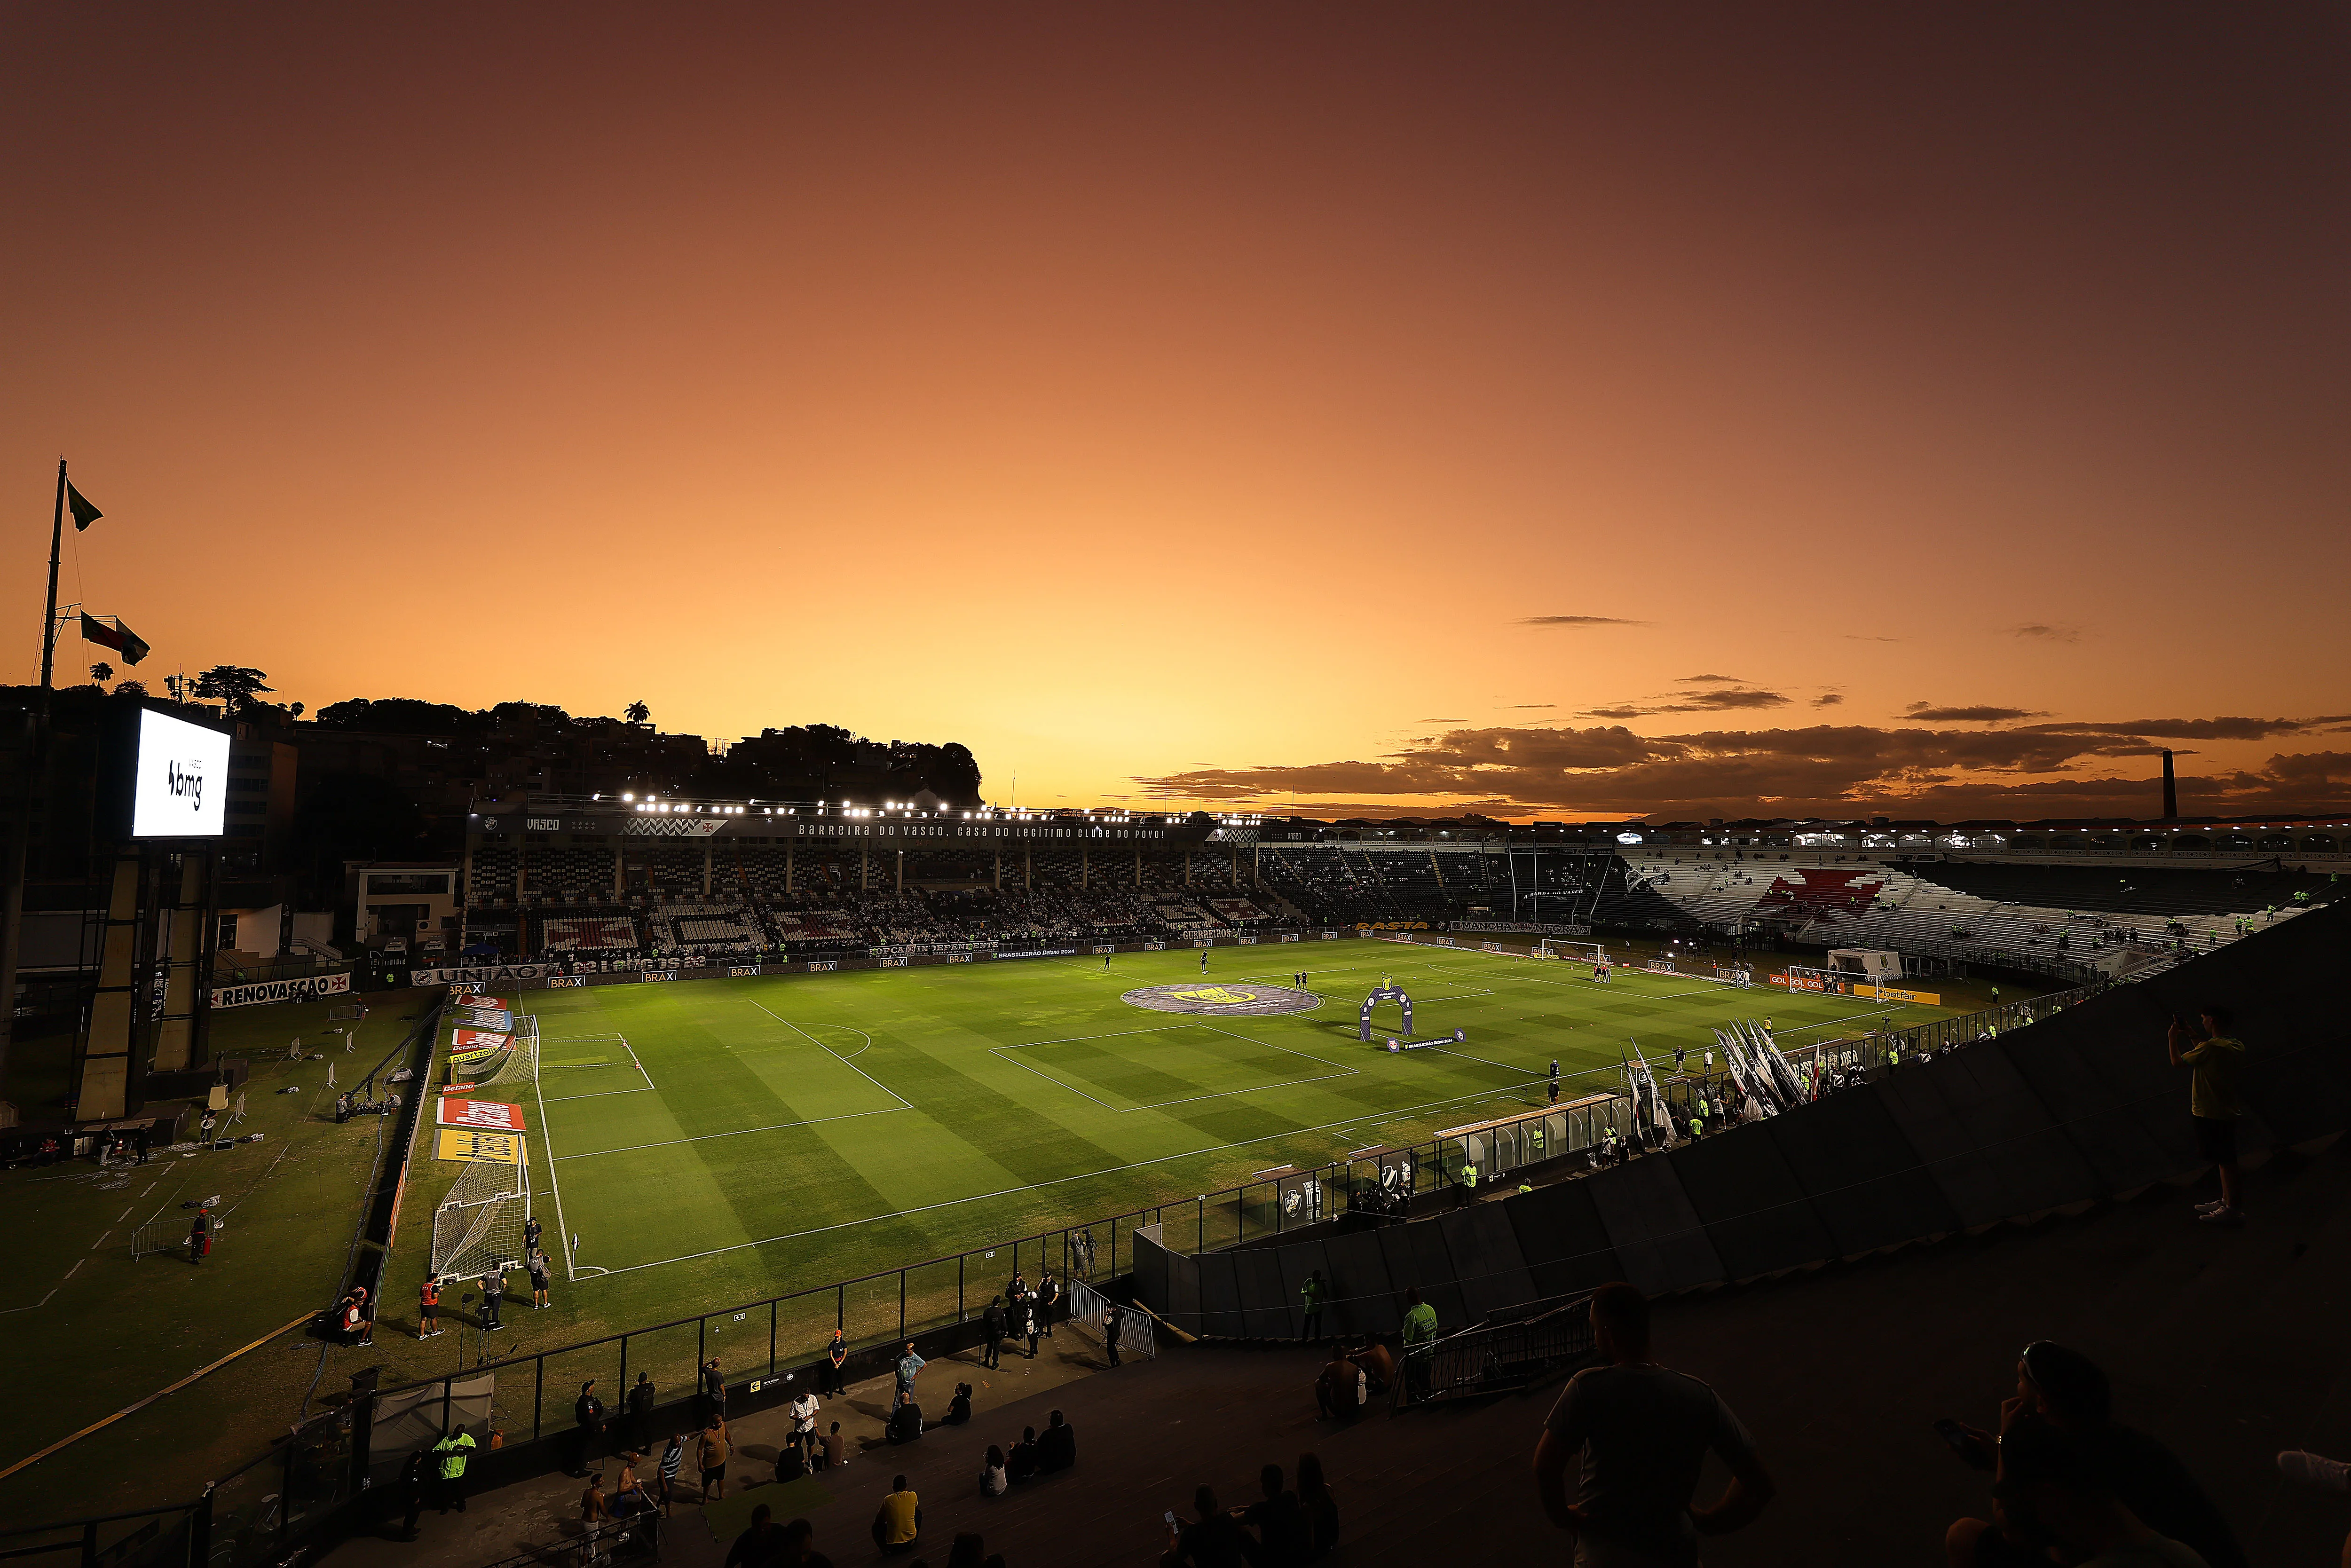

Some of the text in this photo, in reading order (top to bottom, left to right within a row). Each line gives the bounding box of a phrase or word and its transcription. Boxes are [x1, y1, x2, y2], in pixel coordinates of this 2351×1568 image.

[176, 762, 202, 811] bmg
[526, 819, 560, 830] VASCO
[879, 825, 894, 835] DO
[995, 827, 1009, 837] DO
[1117, 829, 1128, 838] DO
[1135, 829, 1164, 838] POVO!
[1356, 922, 1428, 930] RASTA
[1462, 922, 1580, 934] MANCHA NEGRA
[1183, 929, 1231, 940] GUERREIROS
[810, 962, 834, 971] BRAX
[883, 959, 905, 968] BRAX
[1650, 962, 1674, 972] BRAX
[646, 972, 674, 982] BRAX
[731, 966, 758, 977] BRAX
[551, 977, 583, 988] BRAX
[450, 984, 481, 995] BRAX
[1884, 991, 1917, 1001] betfair
[453, 1048, 497, 1063] quartzolit
[443, 1084, 474, 1092] Betano
